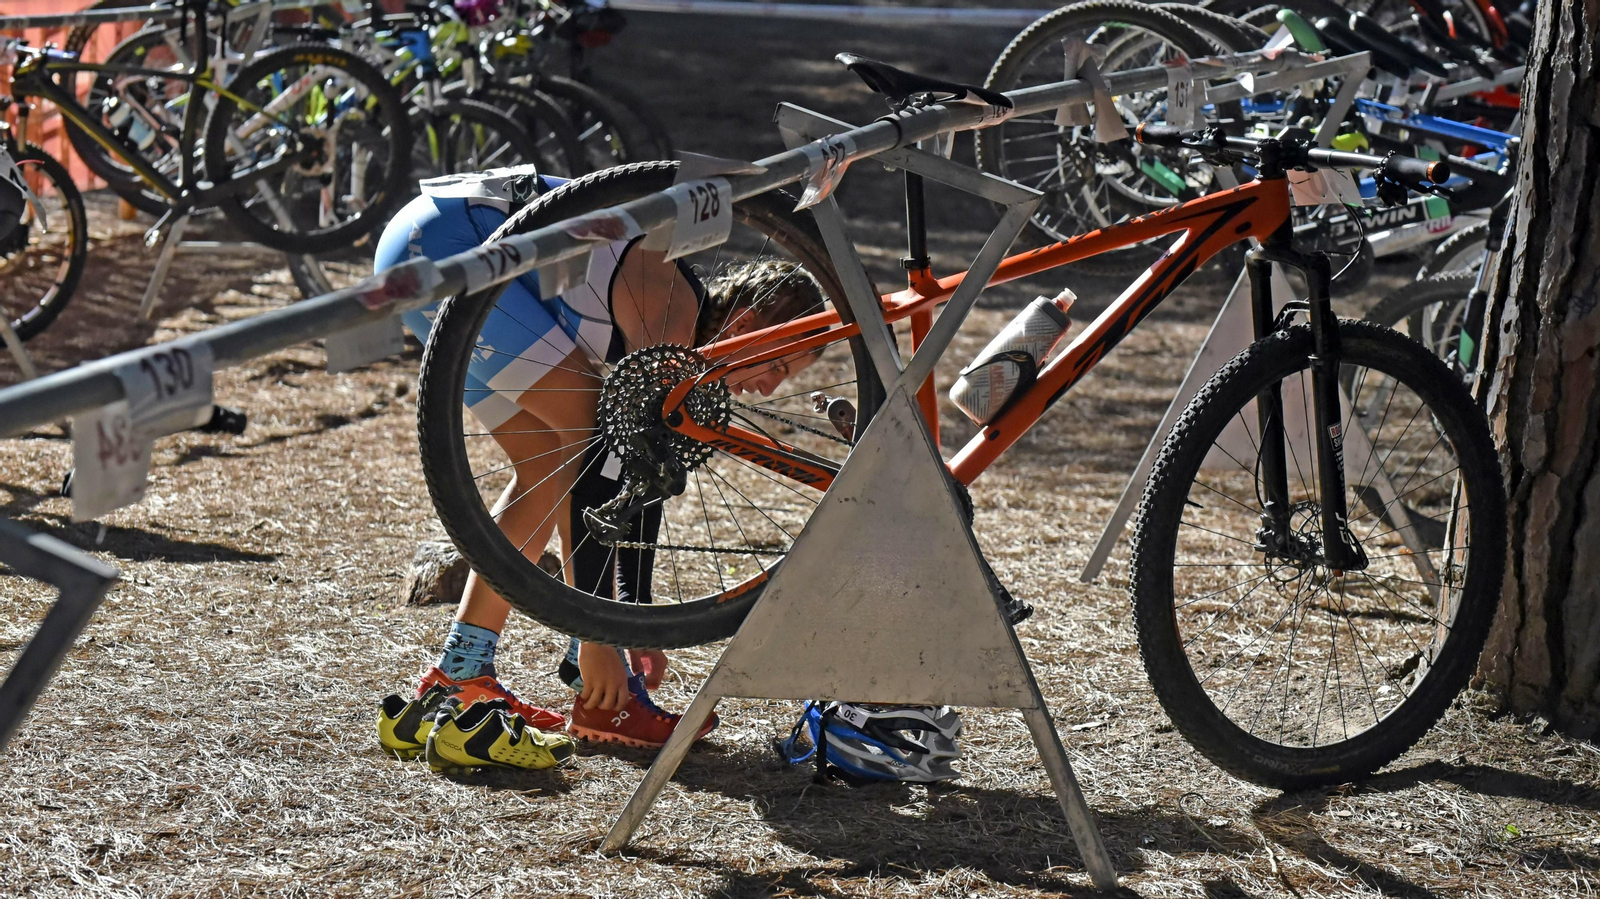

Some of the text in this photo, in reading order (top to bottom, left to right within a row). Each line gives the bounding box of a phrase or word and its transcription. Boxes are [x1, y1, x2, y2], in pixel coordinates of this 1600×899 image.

[688, 182, 720, 224] 128
[140, 347, 195, 400] 130
[440, 738, 463, 753] ROCCA
